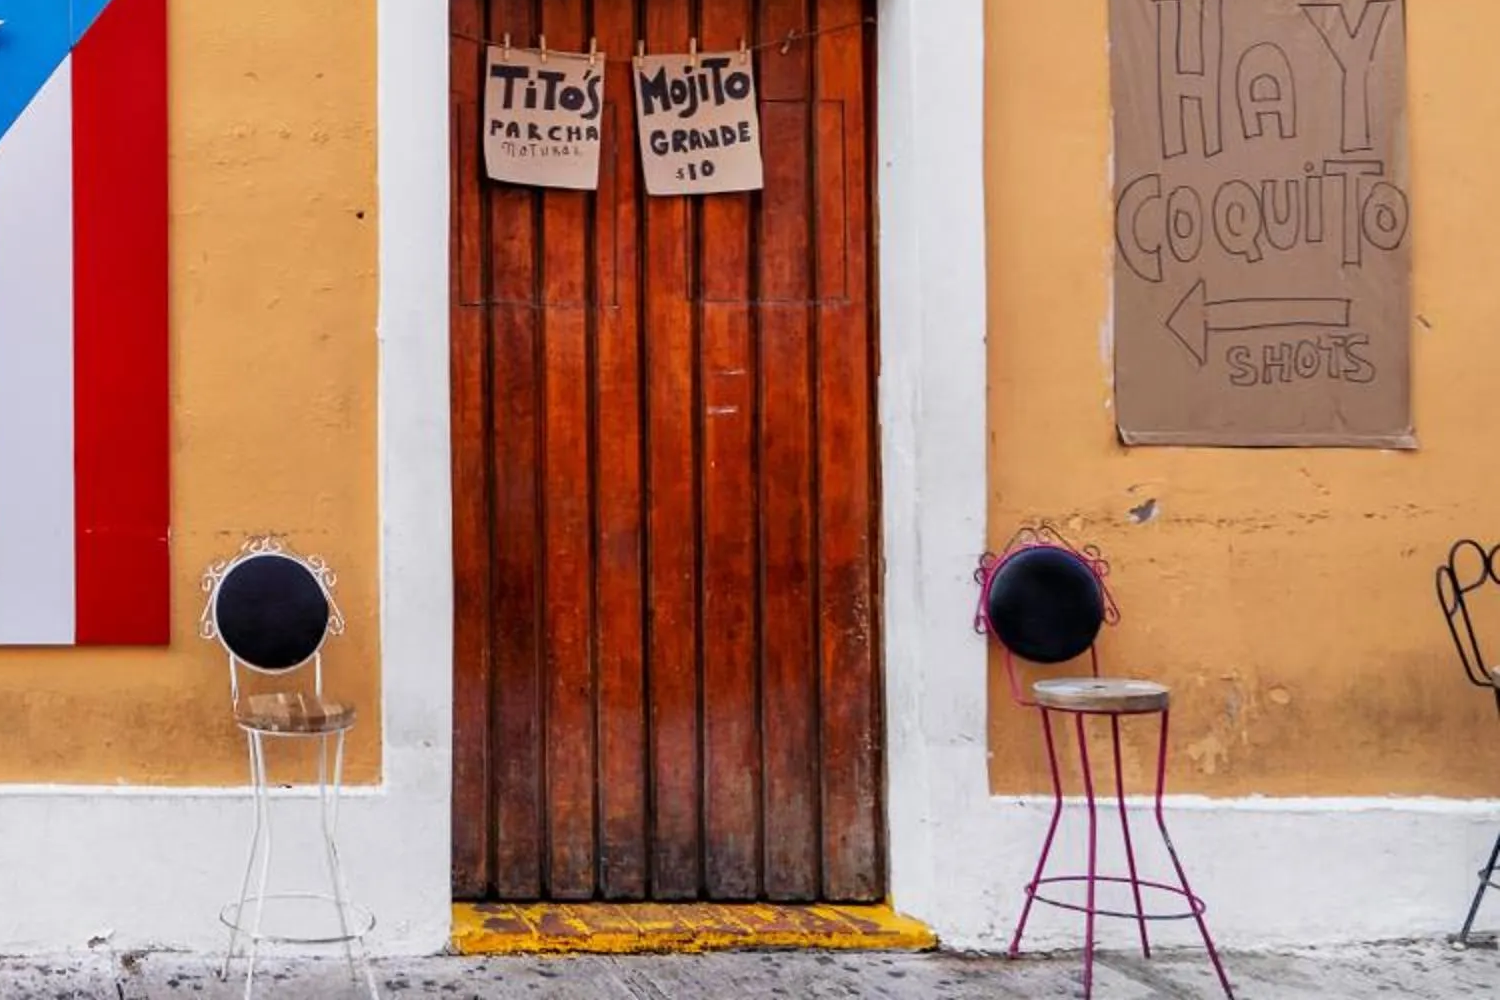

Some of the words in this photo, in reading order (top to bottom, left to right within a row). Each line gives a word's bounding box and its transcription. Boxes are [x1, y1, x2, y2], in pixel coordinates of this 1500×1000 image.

[490, 119, 599, 142] PARCHA
[650, 121, 751, 156] GRANDE
[1226, 334, 1376, 387] SHOTS
